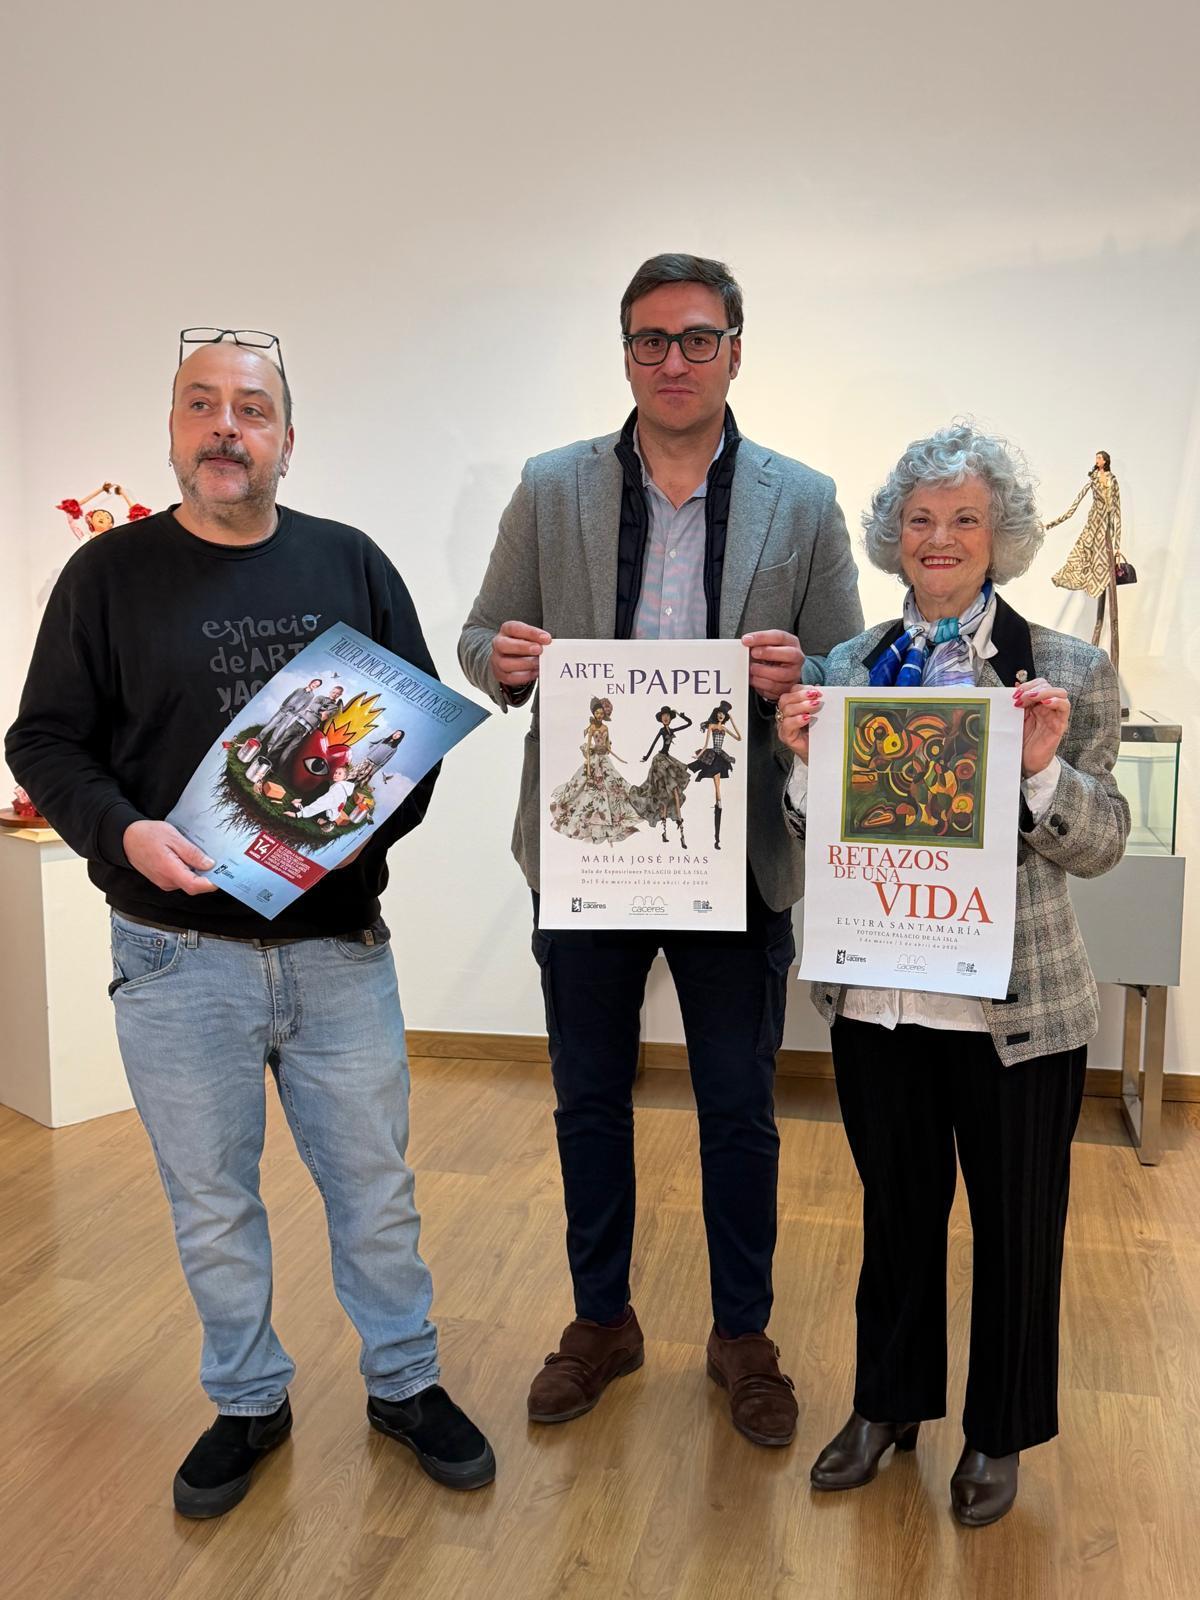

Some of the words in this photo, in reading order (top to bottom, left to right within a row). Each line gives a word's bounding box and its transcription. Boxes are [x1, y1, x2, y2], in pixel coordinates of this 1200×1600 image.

[201, 614, 322, 652] espacio
[209, 646, 247, 674] de
[249, 642, 309, 673] ART
[328, 637, 363, 662] TALLER
[352, 651, 390, 680] JUNIOR
[381, 668, 402, 687] DE
[392, 676, 430, 703] ARCILLA
[420, 691, 440, 710] EN
[432, 700, 463, 723] SECO
[559, 662, 615, 679] ARTE
[606, 683, 625, 695] EN
[627, 669, 732, 695] PAPEL
[253, 838, 271, 855] 14
[827, 844, 949, 871] RETAZOS
[581, 855, 625, 864] MARÍA
[631, 854, 663, 865] JOSÉ
[669, 855, 709, 864] PIÑAS
[834, 865, 857, 880] DE
[862, 867, 902, 883] UNA
[871, 881, 994, 924] VIDA
[837, 917, 884, 929] ELVIRA
[889, 921, 981, 936] SANTAMARÍA
[856, 929, 890, 937] FOTOTECA
[892, 932, 920, 940] PALACIO
